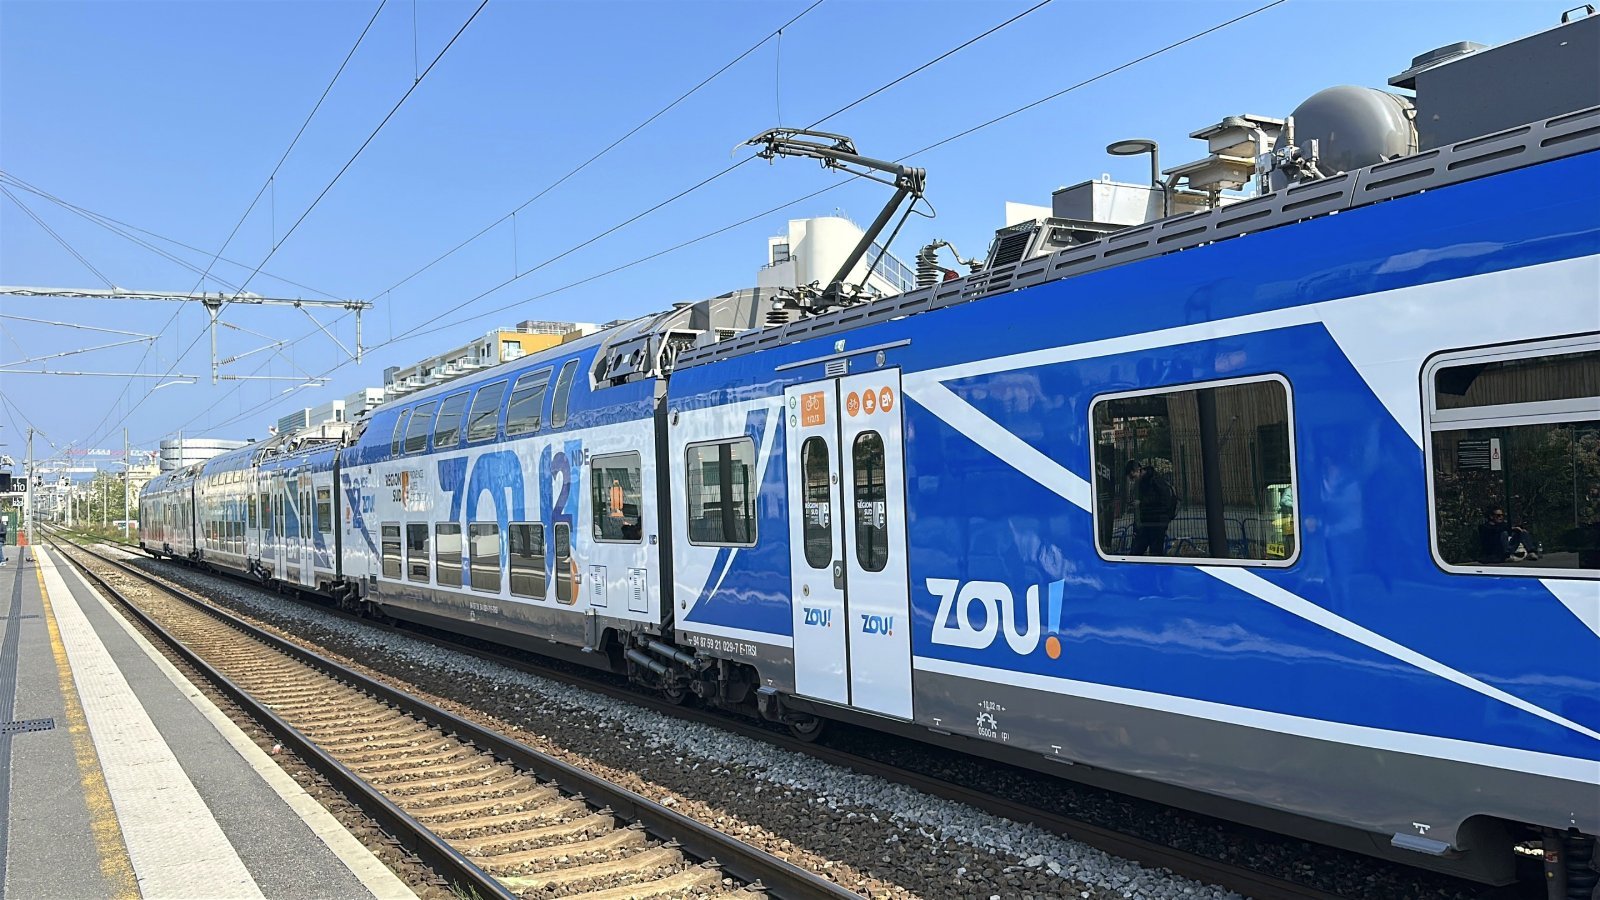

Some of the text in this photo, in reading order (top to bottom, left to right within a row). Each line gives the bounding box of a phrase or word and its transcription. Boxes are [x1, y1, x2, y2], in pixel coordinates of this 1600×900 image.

[803, 607, 832, 628] ZOU!
[861, 614, 894, 636] ZOU!
[925, 578, 1066, 660] ZOU!
[692, 635, 700, 647] 94
[714, 639, 722, 651] 21
